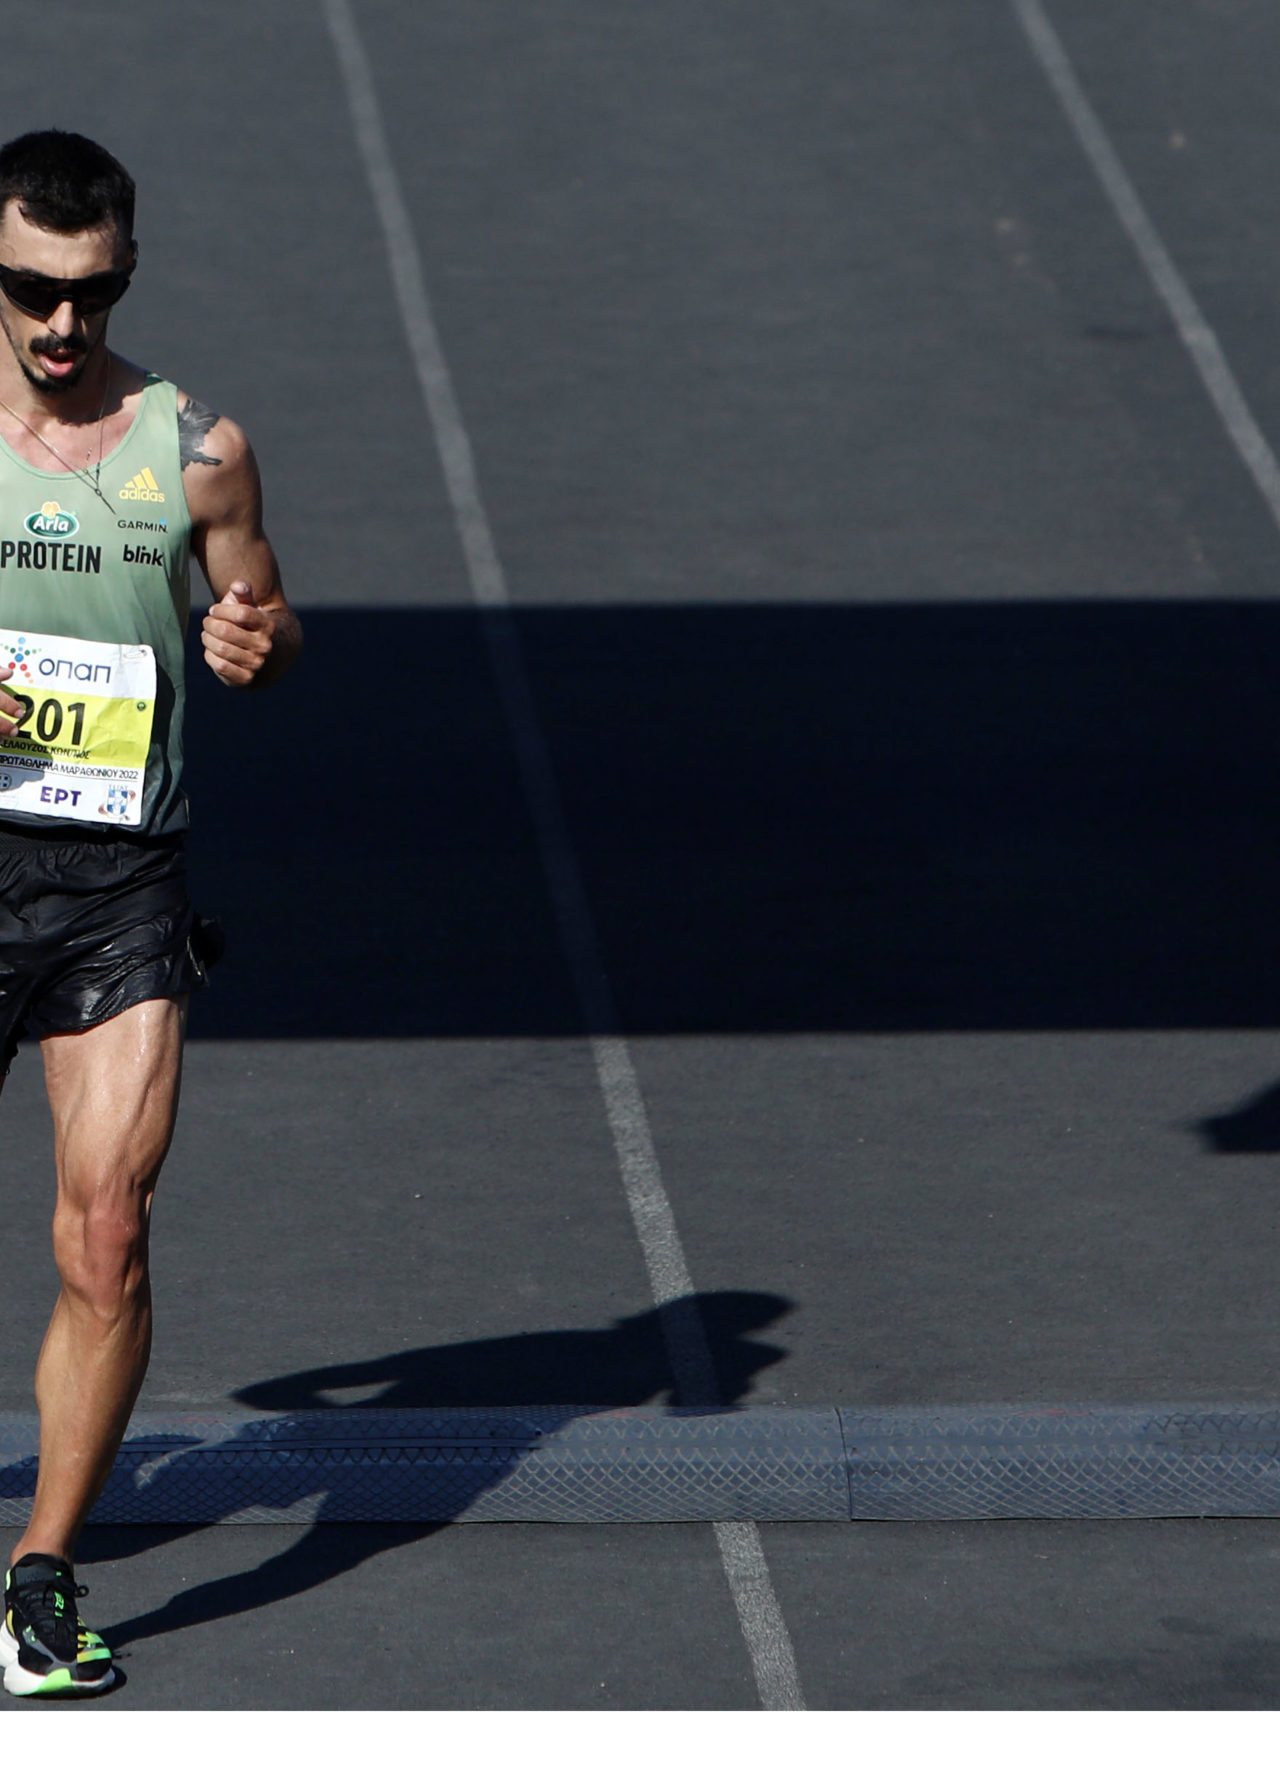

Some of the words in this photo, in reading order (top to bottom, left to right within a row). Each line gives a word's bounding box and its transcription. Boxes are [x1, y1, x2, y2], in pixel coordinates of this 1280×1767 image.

[119, 487, 165, 503] adidas
[32, 515, 70, 533] Arla
[117, 519, 168, 534] GARMIN
[0, 540, 102, 574] PROTEIN
[122, 544, 164, 567] blink
[13, 694, 86, 746] 201
[119, 770, 139, 780] 2022
